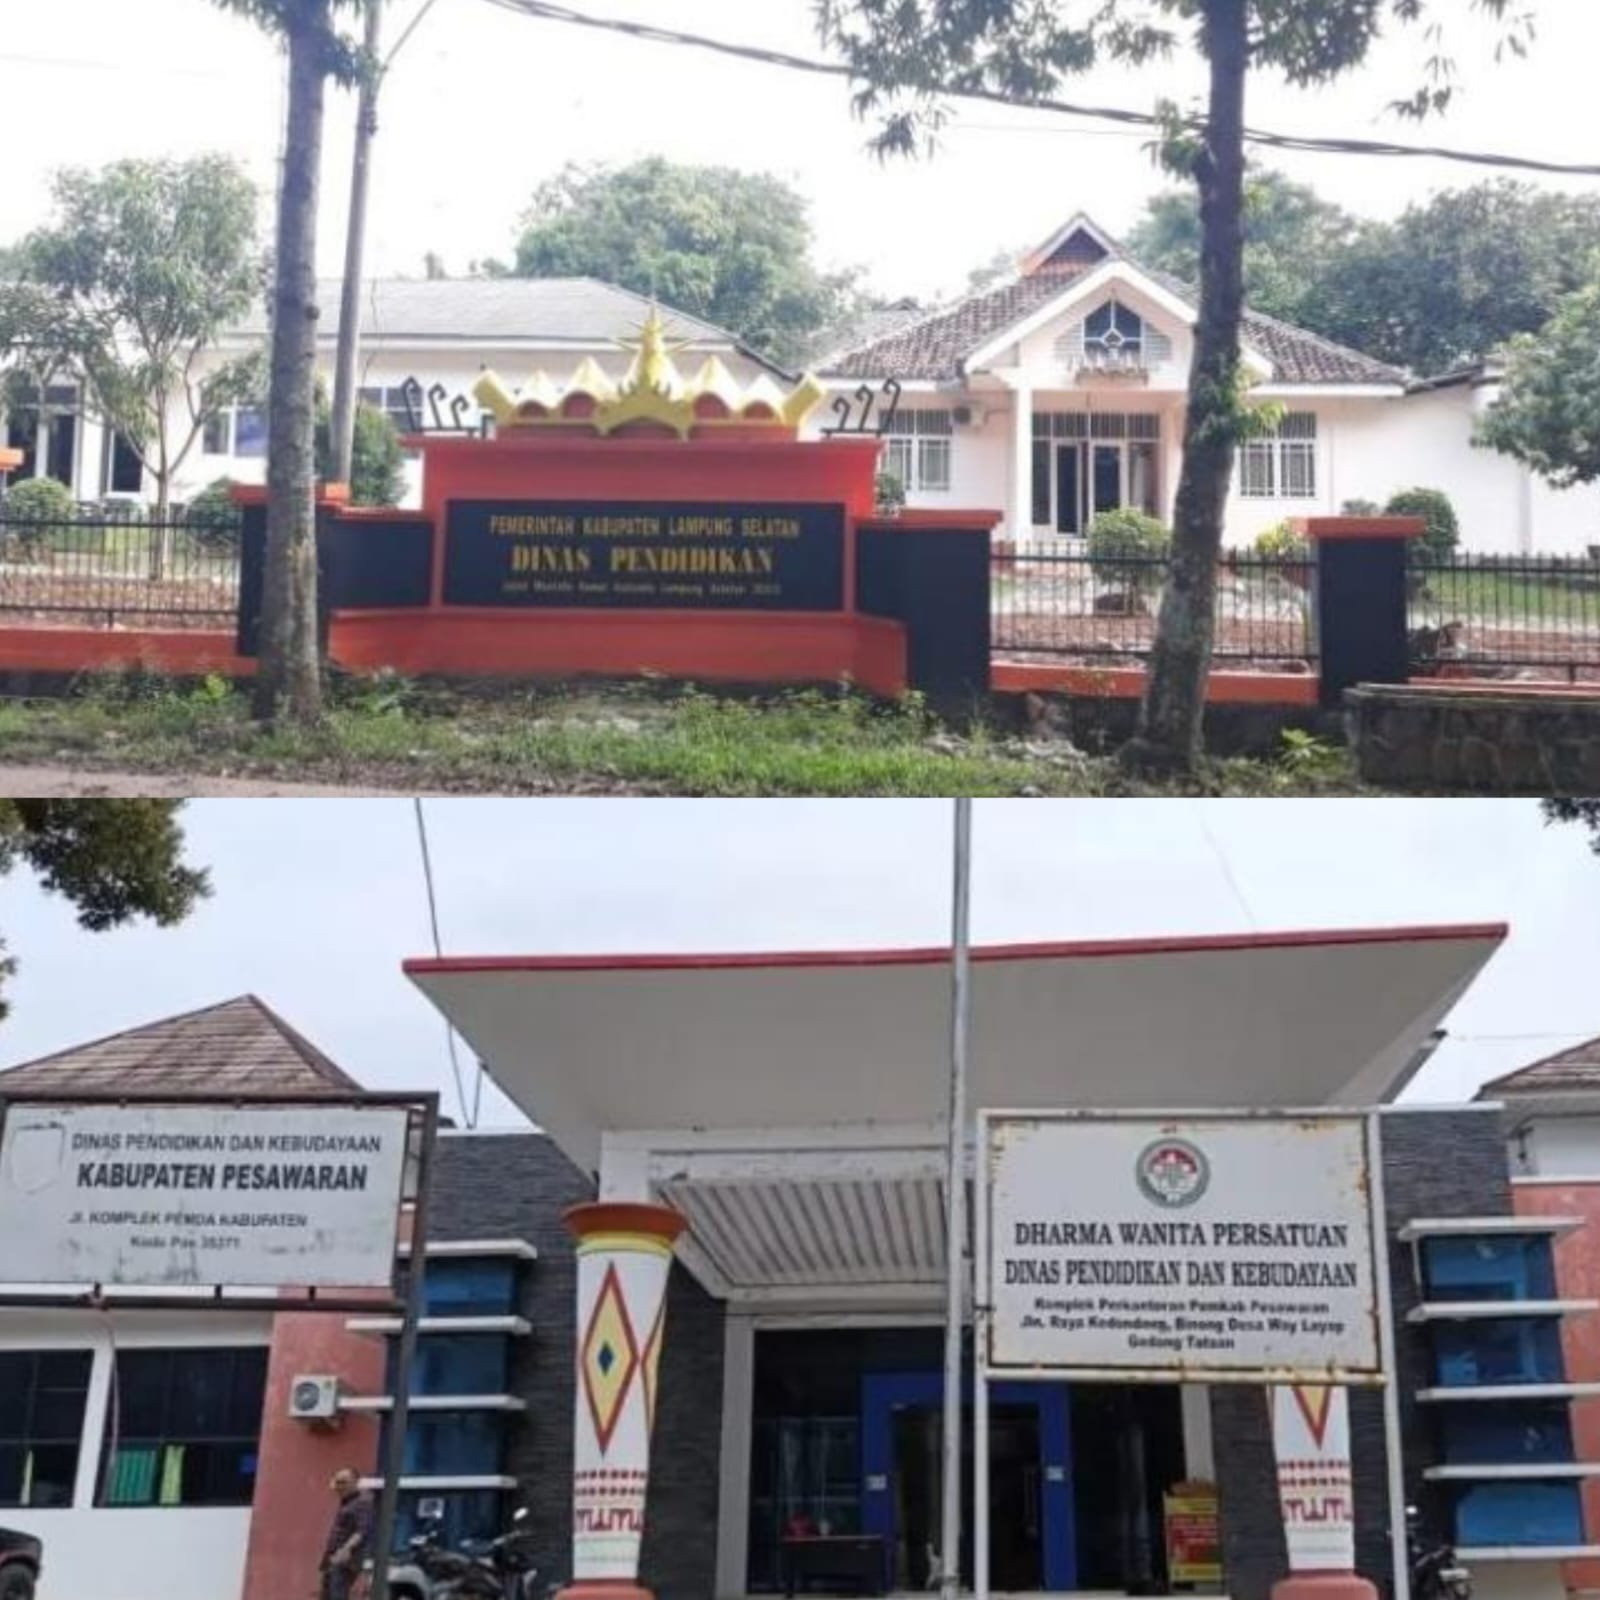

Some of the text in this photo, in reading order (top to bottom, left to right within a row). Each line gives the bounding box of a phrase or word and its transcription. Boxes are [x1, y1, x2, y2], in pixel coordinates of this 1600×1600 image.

[669, 517, 733, 535] LAMPUNG
[741, 518, 799, 537] SELATAN
[511, 545, 773, 573] DINAS PENDIDIKAN
[71, 1133, 382, 1153] DINAS PENDIDIKAN DAN KEBUDAYAAN
[77, 1162, 367, 1191] KABUPATEN PESAWARAN
[89, 1212, 160, 1225] KOMPLEK
[165, 1212, 215, 1226] PEMDA
[219, 1213, 307, 1227] KABUPATEN
[1015, 1223, 1348, 1247] DHARMA WANITA PERSATUAN
[1005, 1260, 1357, 1288] DINAS PENDIDIKAN DAN KEBUDAYAAN
[1050, 1315, 1084, 1331] Raya
